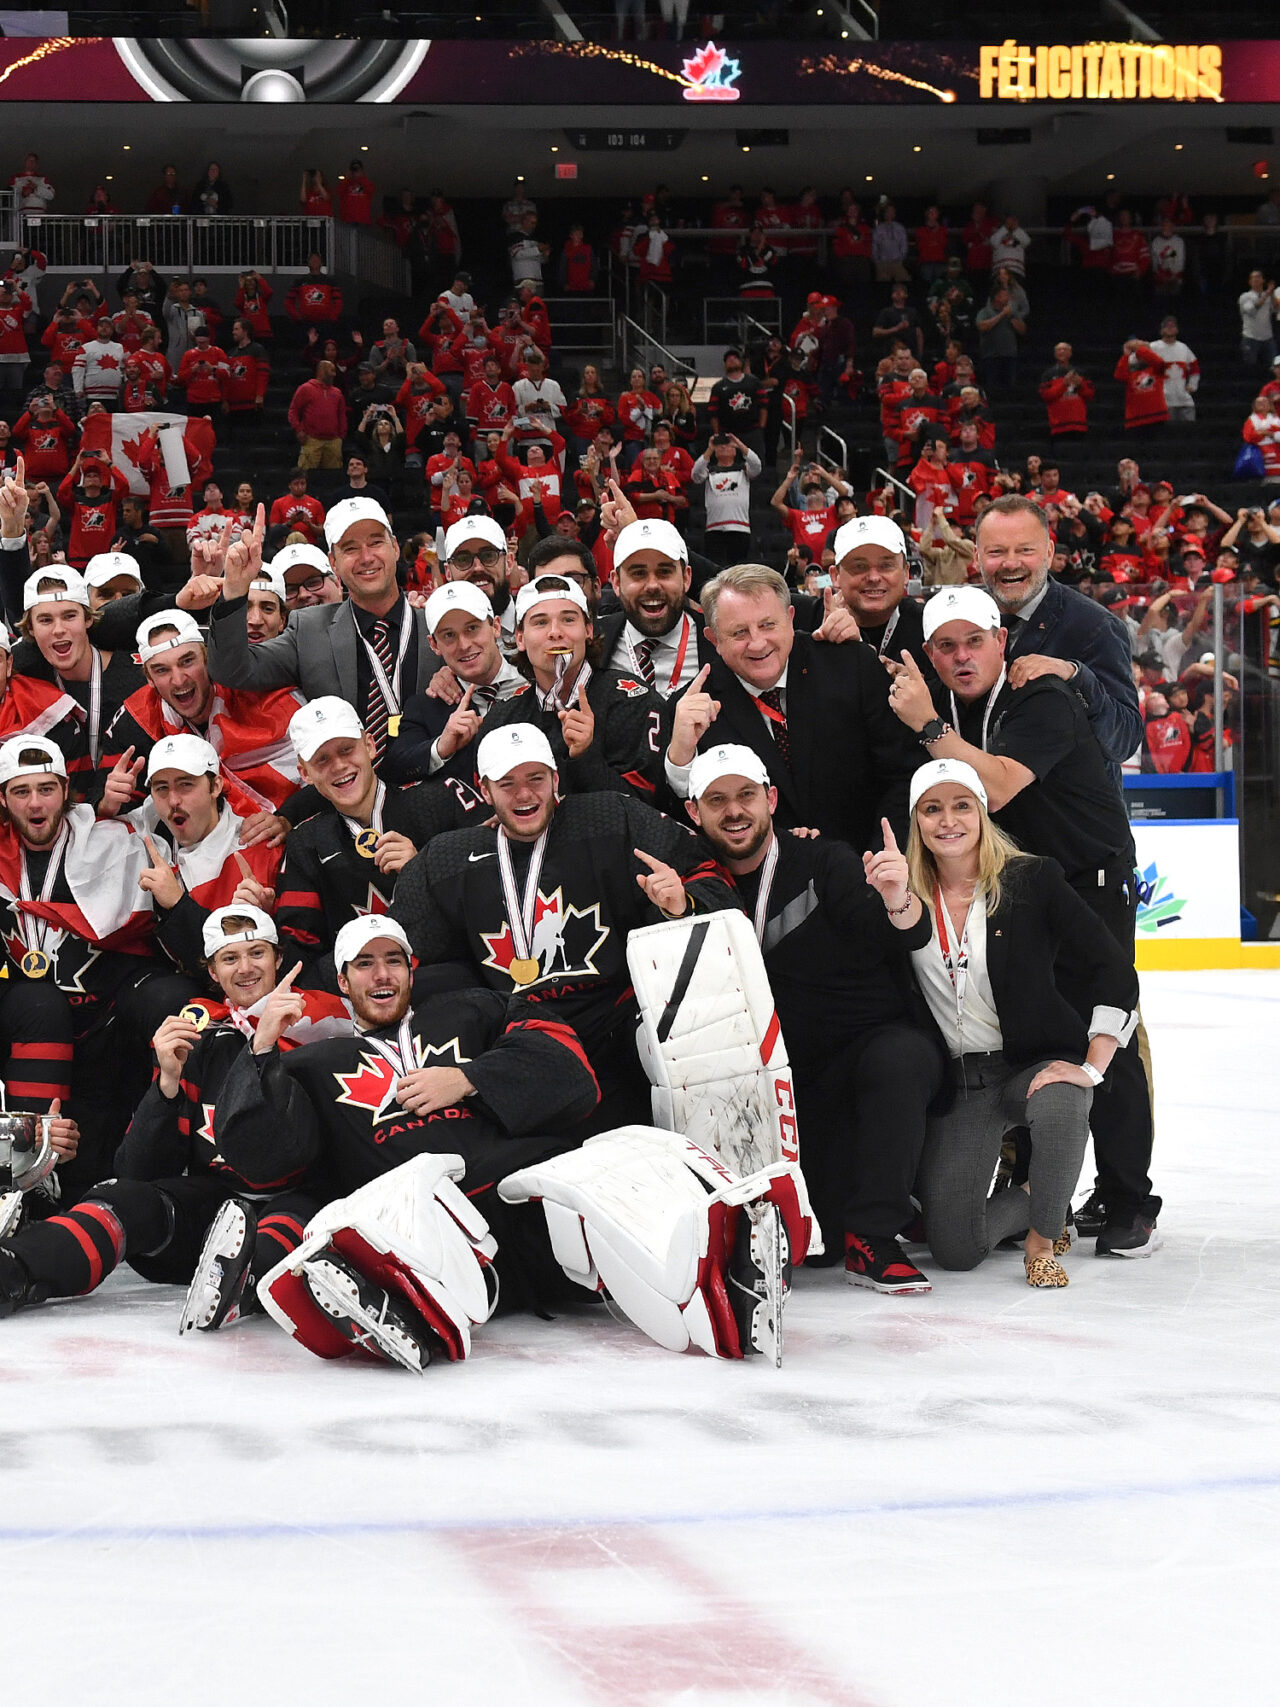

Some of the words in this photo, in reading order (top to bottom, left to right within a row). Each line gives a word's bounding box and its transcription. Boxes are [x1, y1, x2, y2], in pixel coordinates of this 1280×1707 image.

[980, 40, 1222, 99] FÉLICITATIONS
[608, 135, 623, 145] 103
[630, 135, 645, 145] 104
[373, 1107, 476, 1145] CANADA
